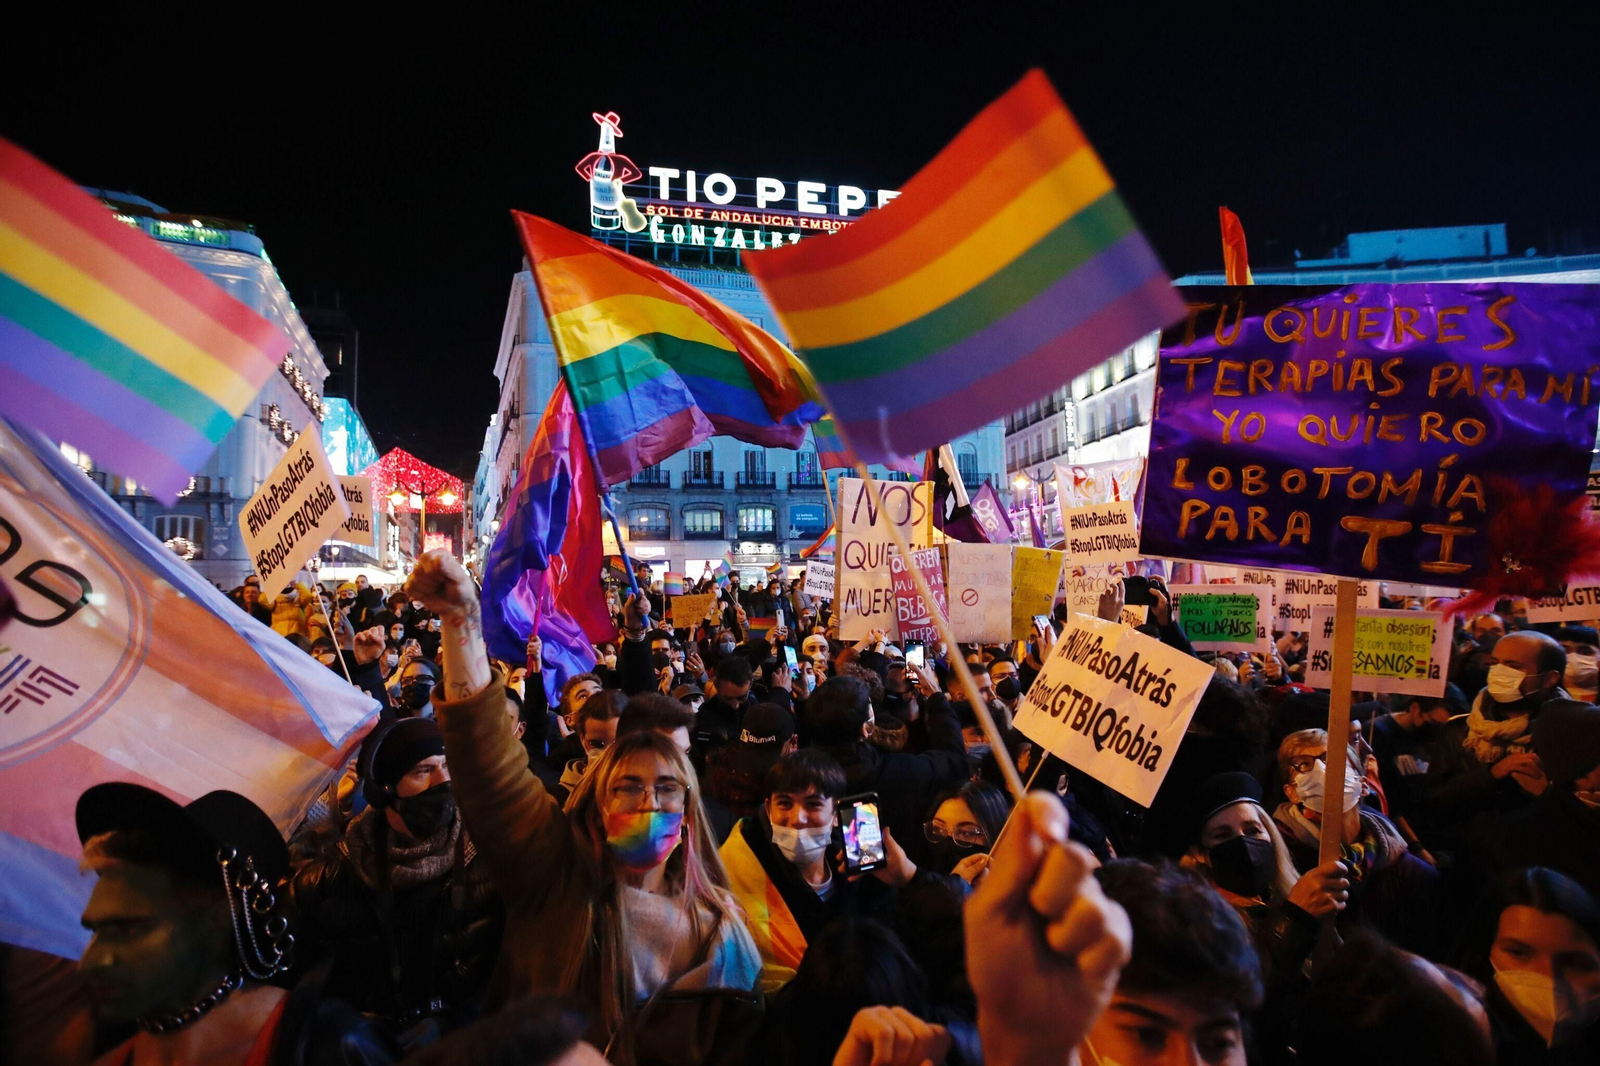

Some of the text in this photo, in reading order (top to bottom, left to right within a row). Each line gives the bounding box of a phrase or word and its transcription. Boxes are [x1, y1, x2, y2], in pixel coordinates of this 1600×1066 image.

[649, 166, 737, 205] TIO
[646, 204, 680, 218] SOL
[684, 207, 704, 220] DE
[710, 210, 795, 228] ANDALUCIA
[1184, 299, 1243, 347] TU
[1428, 362, 1527, 400] PARA
[1212, 408, 1267, 444] YO
[246, 448, 315, 539] #NiUnPasoAtrás
[852, 480, 926, 527] NOS
[256, 481, 336, 582] #StopLGTBIQfobia
[1070, 508, 1128, 530] #NiUnPasoAtrás
[1177, 499, 1311, 547] PARA
[1070, 533, 1137, 556] #StopLGTBIQfobia
[1386, 618, 1431, 637] obsesión
[1057, 627, 1177, 708] #NiUnPasoAtrás
[1026, 673, 1163, 773] #StopLGTBIQfobia
